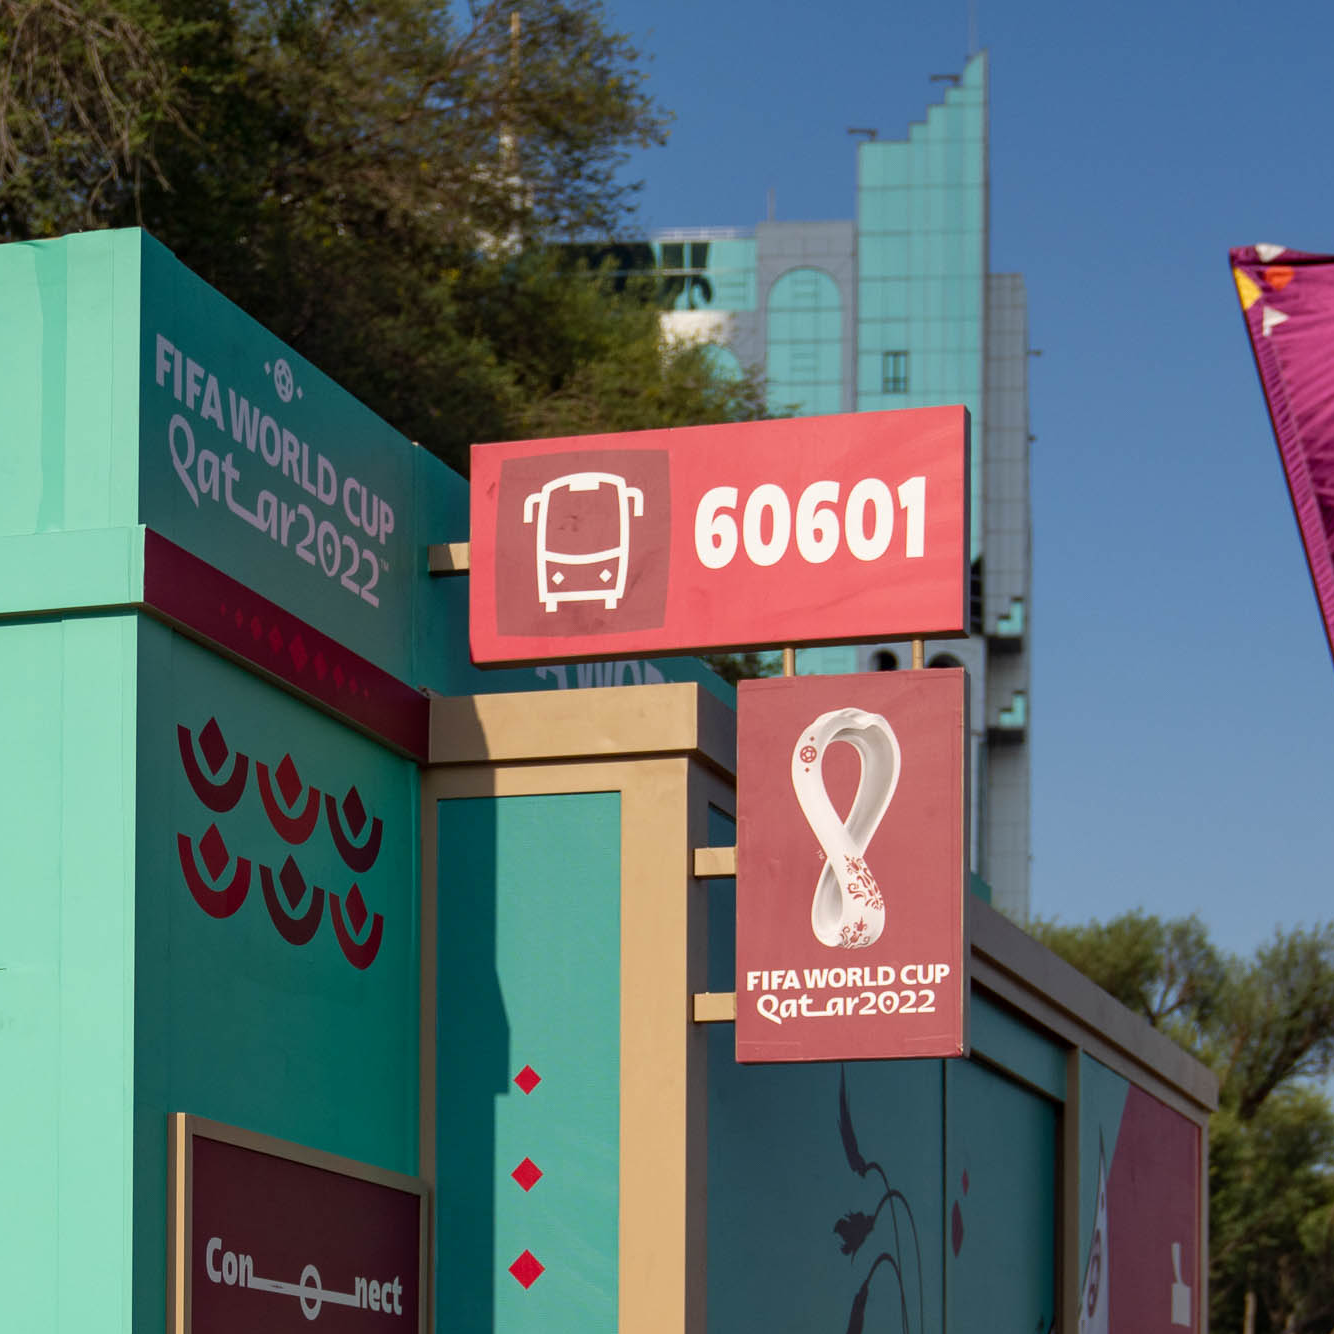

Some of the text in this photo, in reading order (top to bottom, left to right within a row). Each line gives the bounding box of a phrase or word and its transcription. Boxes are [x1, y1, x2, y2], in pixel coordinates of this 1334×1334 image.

[156, 333, 395, 545] FIFA WORLD CUP
[694, 476, 926, 570] 60601
[746, 963, 950, 991] FIFA WORLD CUP
